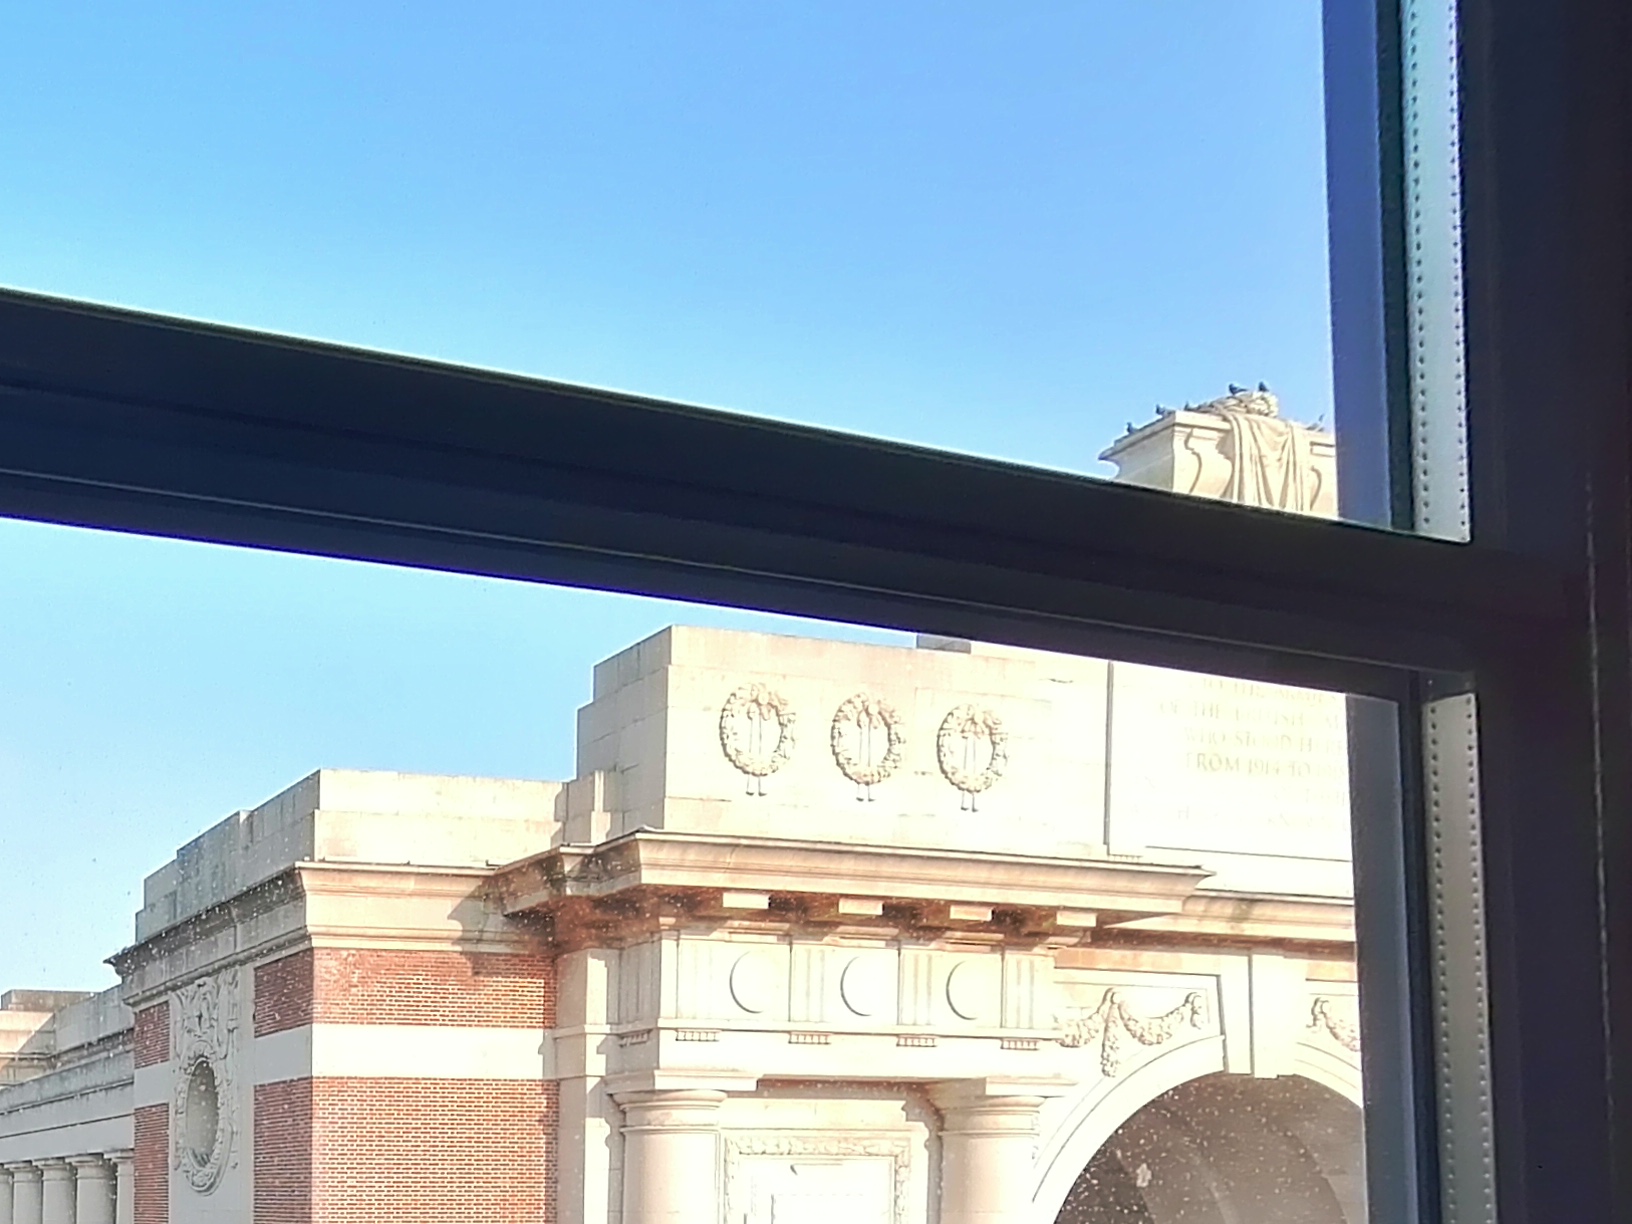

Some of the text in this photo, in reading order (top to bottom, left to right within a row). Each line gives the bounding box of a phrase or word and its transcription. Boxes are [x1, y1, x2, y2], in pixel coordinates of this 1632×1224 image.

[1193, 700, 1220, 719] THE
[1186, 752, 1240, 772] FROM
[1248, 757, 1280, 775] 1914
[1288, 760, 1311, 777] TO
